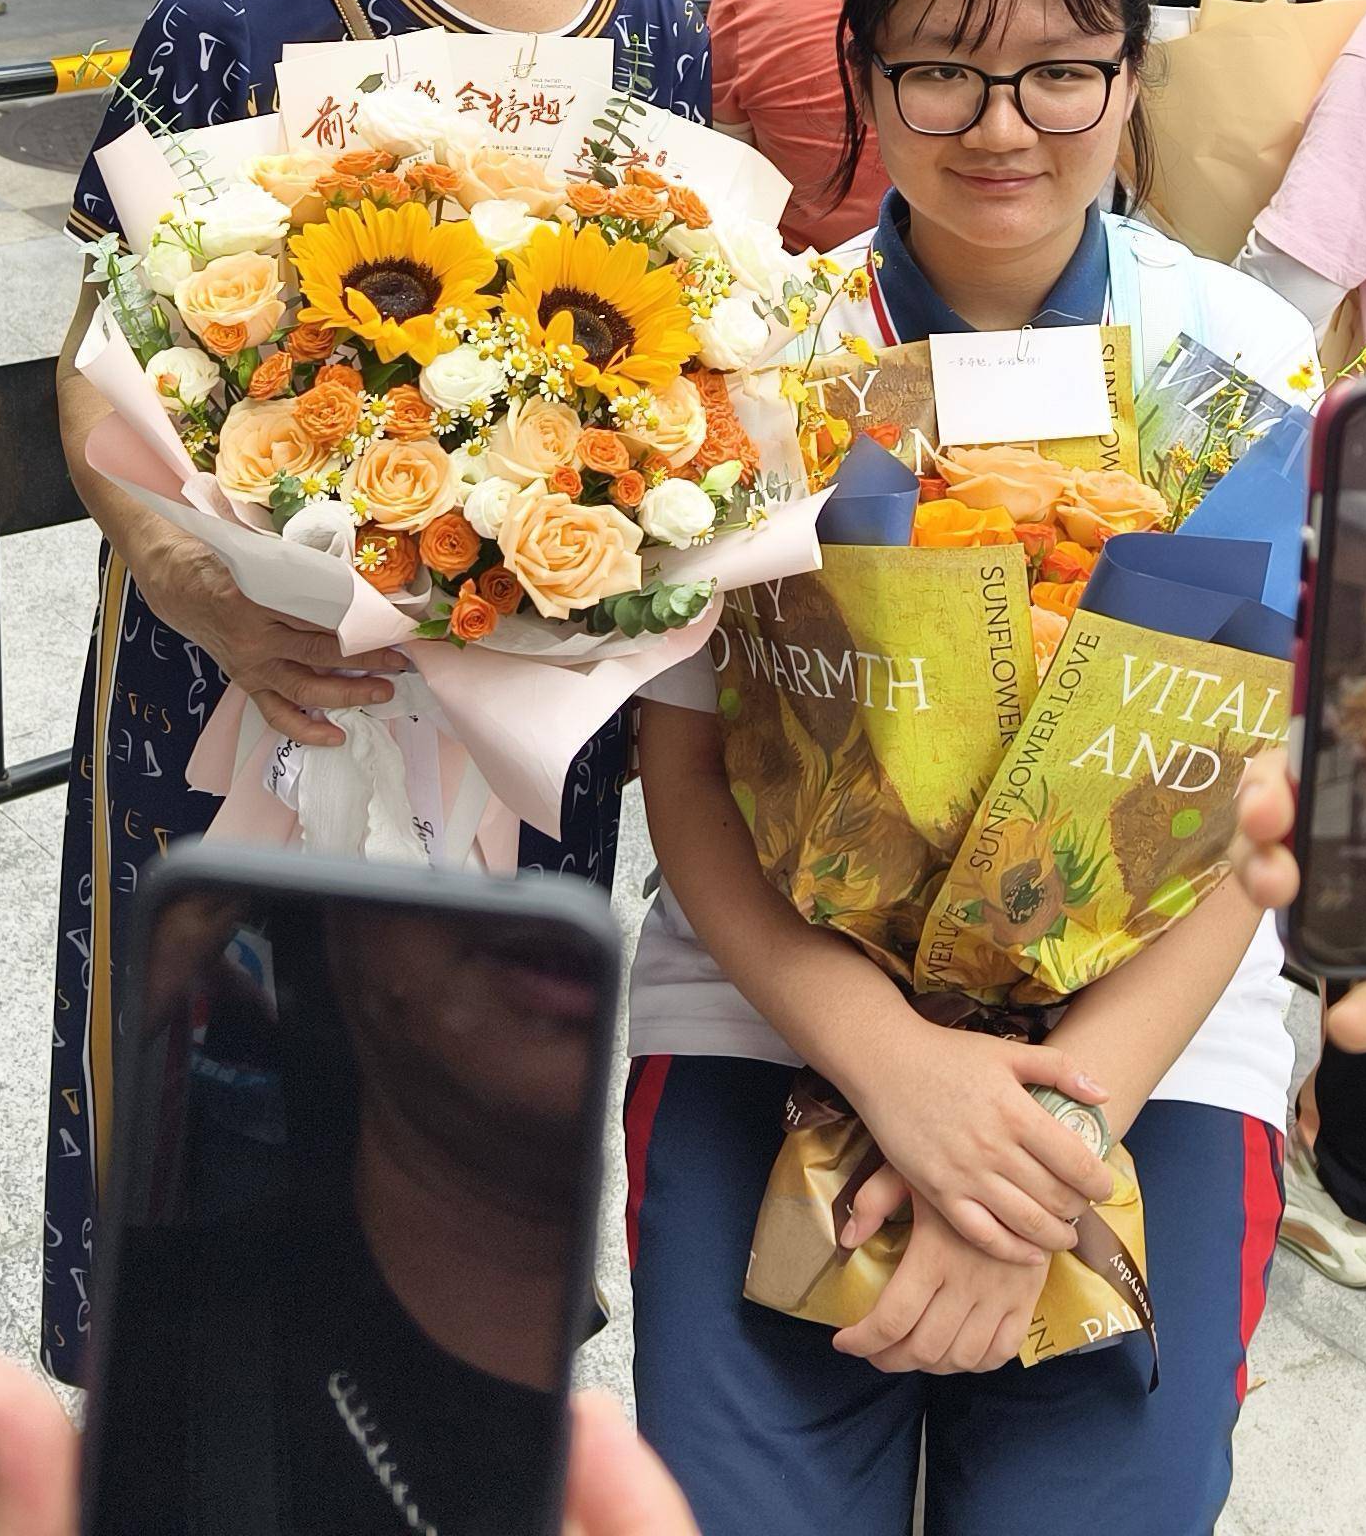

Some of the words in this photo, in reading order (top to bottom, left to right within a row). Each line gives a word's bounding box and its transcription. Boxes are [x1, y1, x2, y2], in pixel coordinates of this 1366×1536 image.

[737, 628, 932, 712] WARMTH
[1121, 653, 1291, 742] VITAL
[969, 709, 1064, 873] SUNFLOWER
[1048, 630, 1101, 704] LOVE
[1068, 724, 1221, 794] AND
